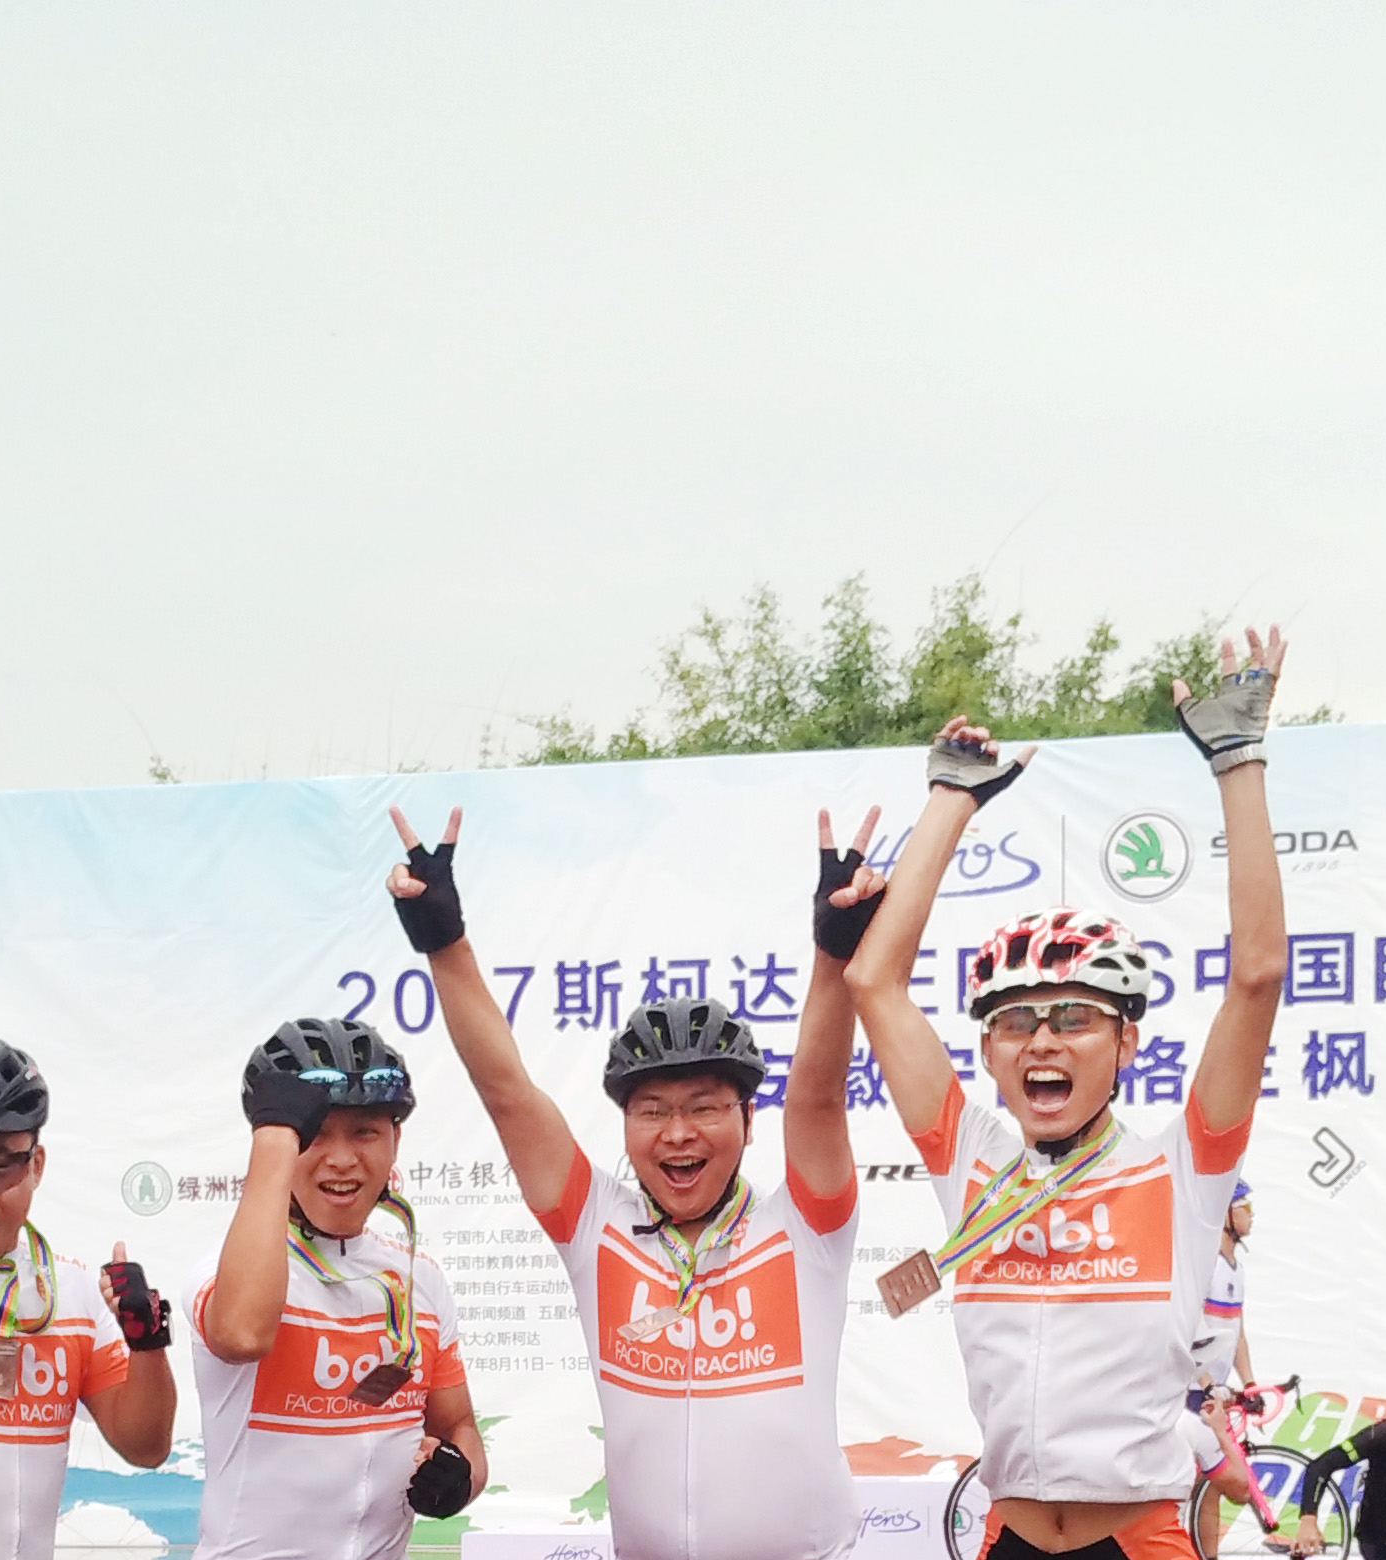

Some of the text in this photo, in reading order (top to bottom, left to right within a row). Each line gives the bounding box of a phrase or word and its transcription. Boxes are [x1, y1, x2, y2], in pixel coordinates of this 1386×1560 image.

[410, 1194, 451, 1207] CHINA
[455, 1193, 490, 1206] CITIC
[442, 1229, 543, 1246] 宁国市人民政府
[442, 1254, 560, 1272] 宁国市教育体育局
[1050, 1256, 1138, 1282] RACING
[447, 1280, 575, 1297] 海市自行车运动协
[615, 1340, 776, 1377] FACTORY RACING
[381, 1390, 427, 1410] ACING
